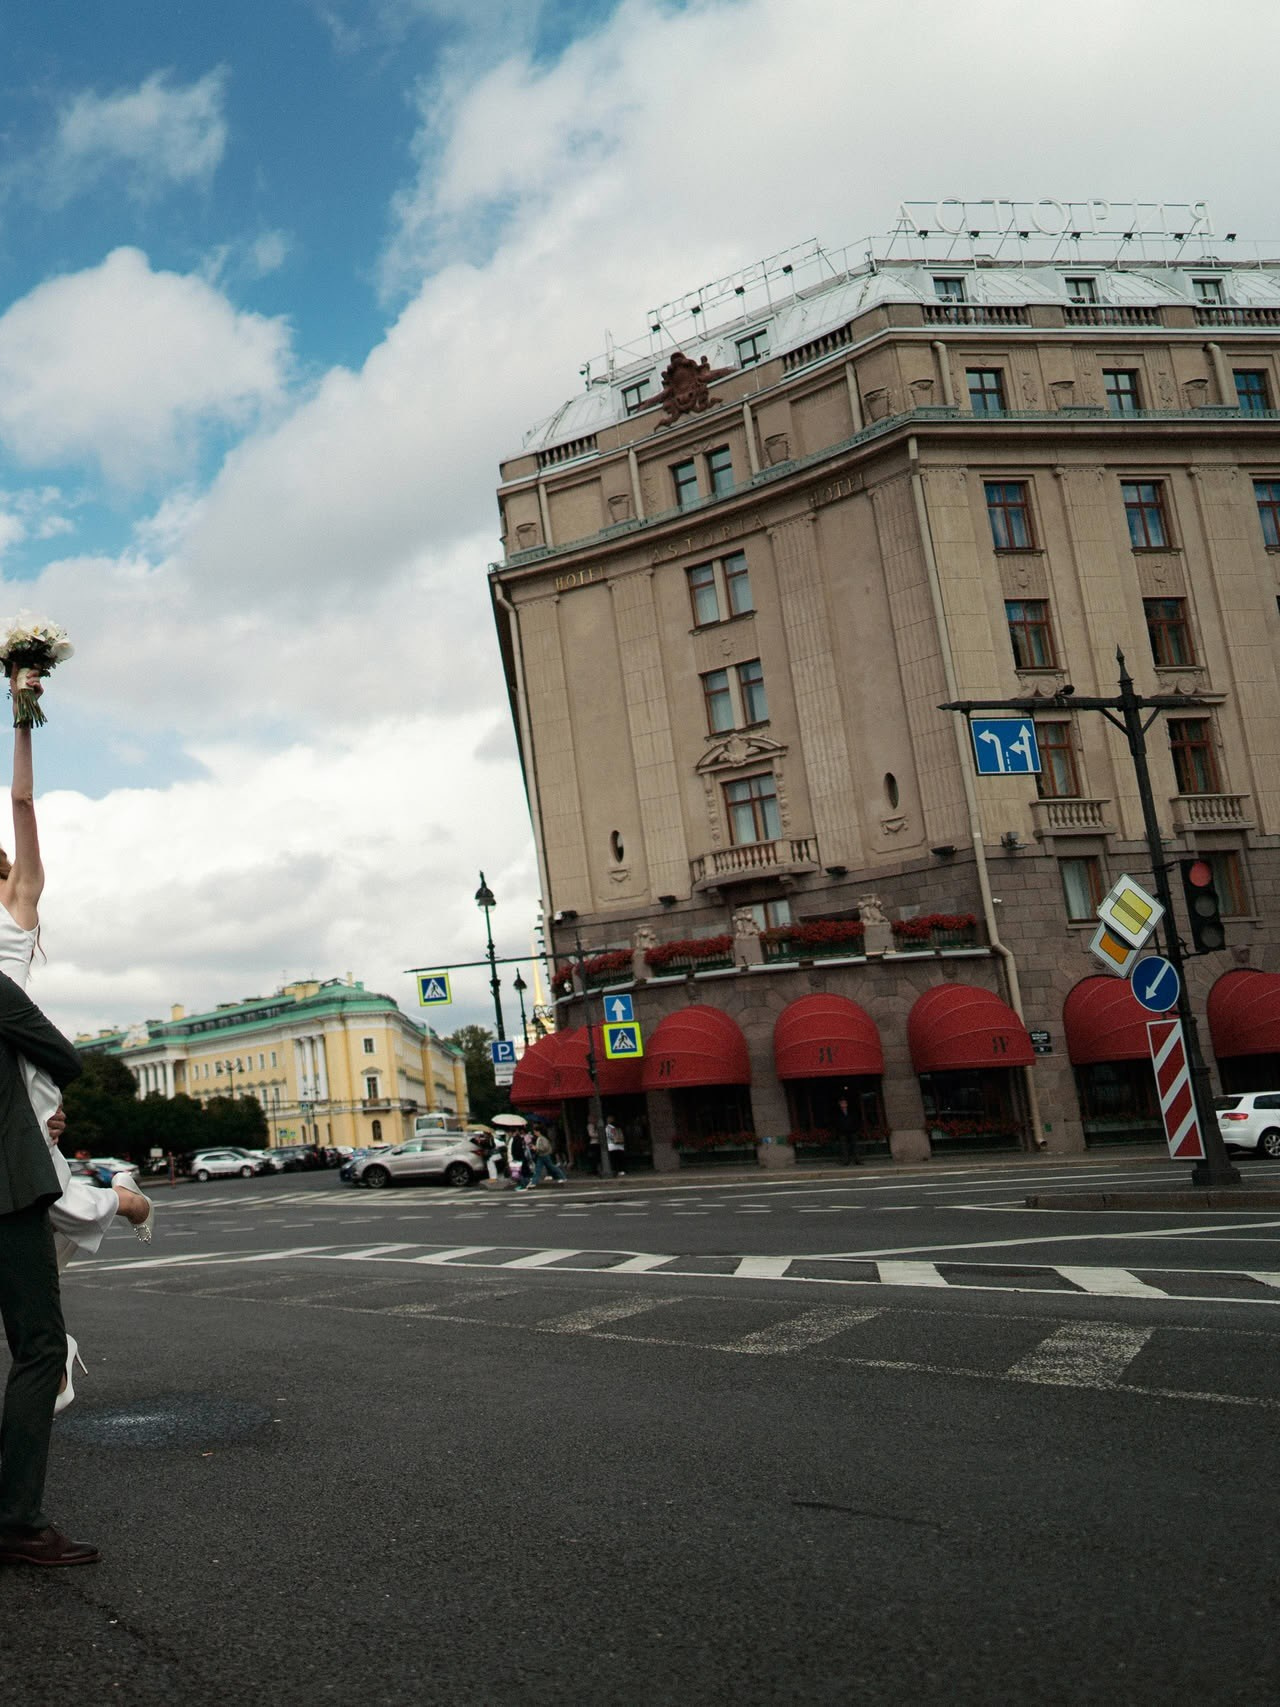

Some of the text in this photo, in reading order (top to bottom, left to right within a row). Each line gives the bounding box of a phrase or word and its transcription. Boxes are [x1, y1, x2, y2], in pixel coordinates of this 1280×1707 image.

[887, 197, 1217, 237] АСТОРИЯ
[646, 238, 821, 328] ГОСТИНИ
[651, 514, 765, 563] ASTORIA
[497, 1044, 511, 1062] P
